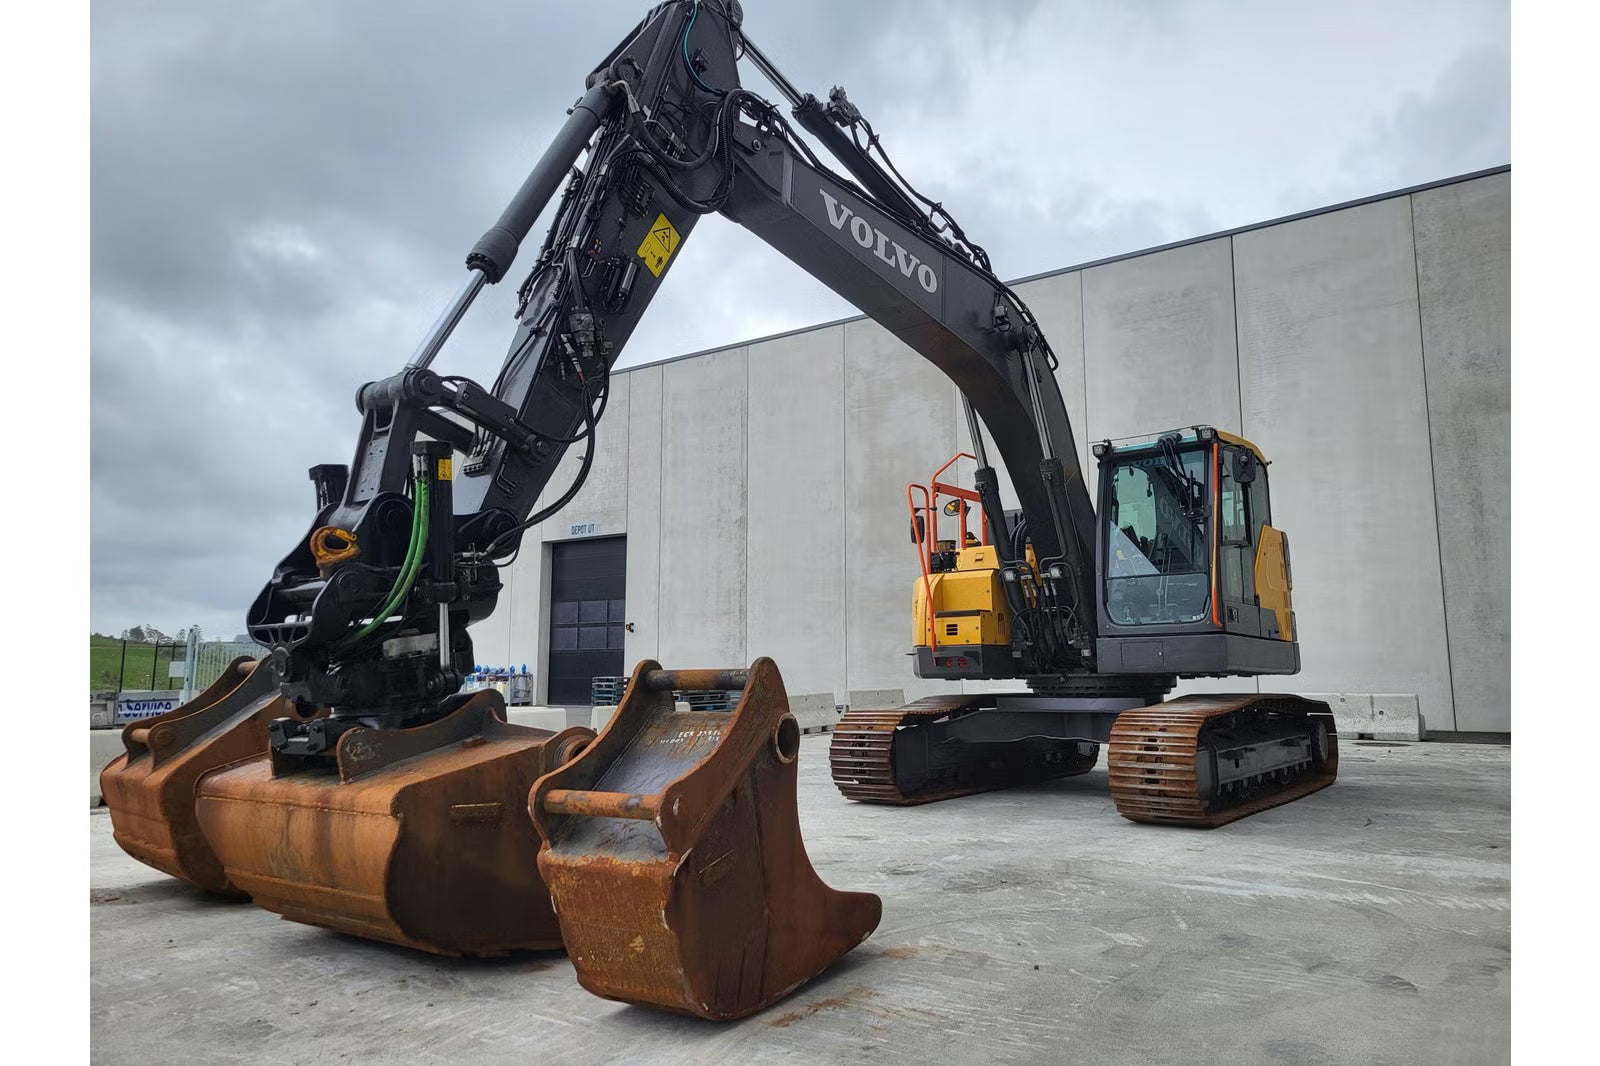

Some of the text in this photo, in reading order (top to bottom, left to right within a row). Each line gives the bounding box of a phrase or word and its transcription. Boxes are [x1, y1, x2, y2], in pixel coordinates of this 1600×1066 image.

[820, 188, 938, 294] VOLVO
[571, 525, 586, 535] DEPOT
[125, 700, 171, 717] Service
